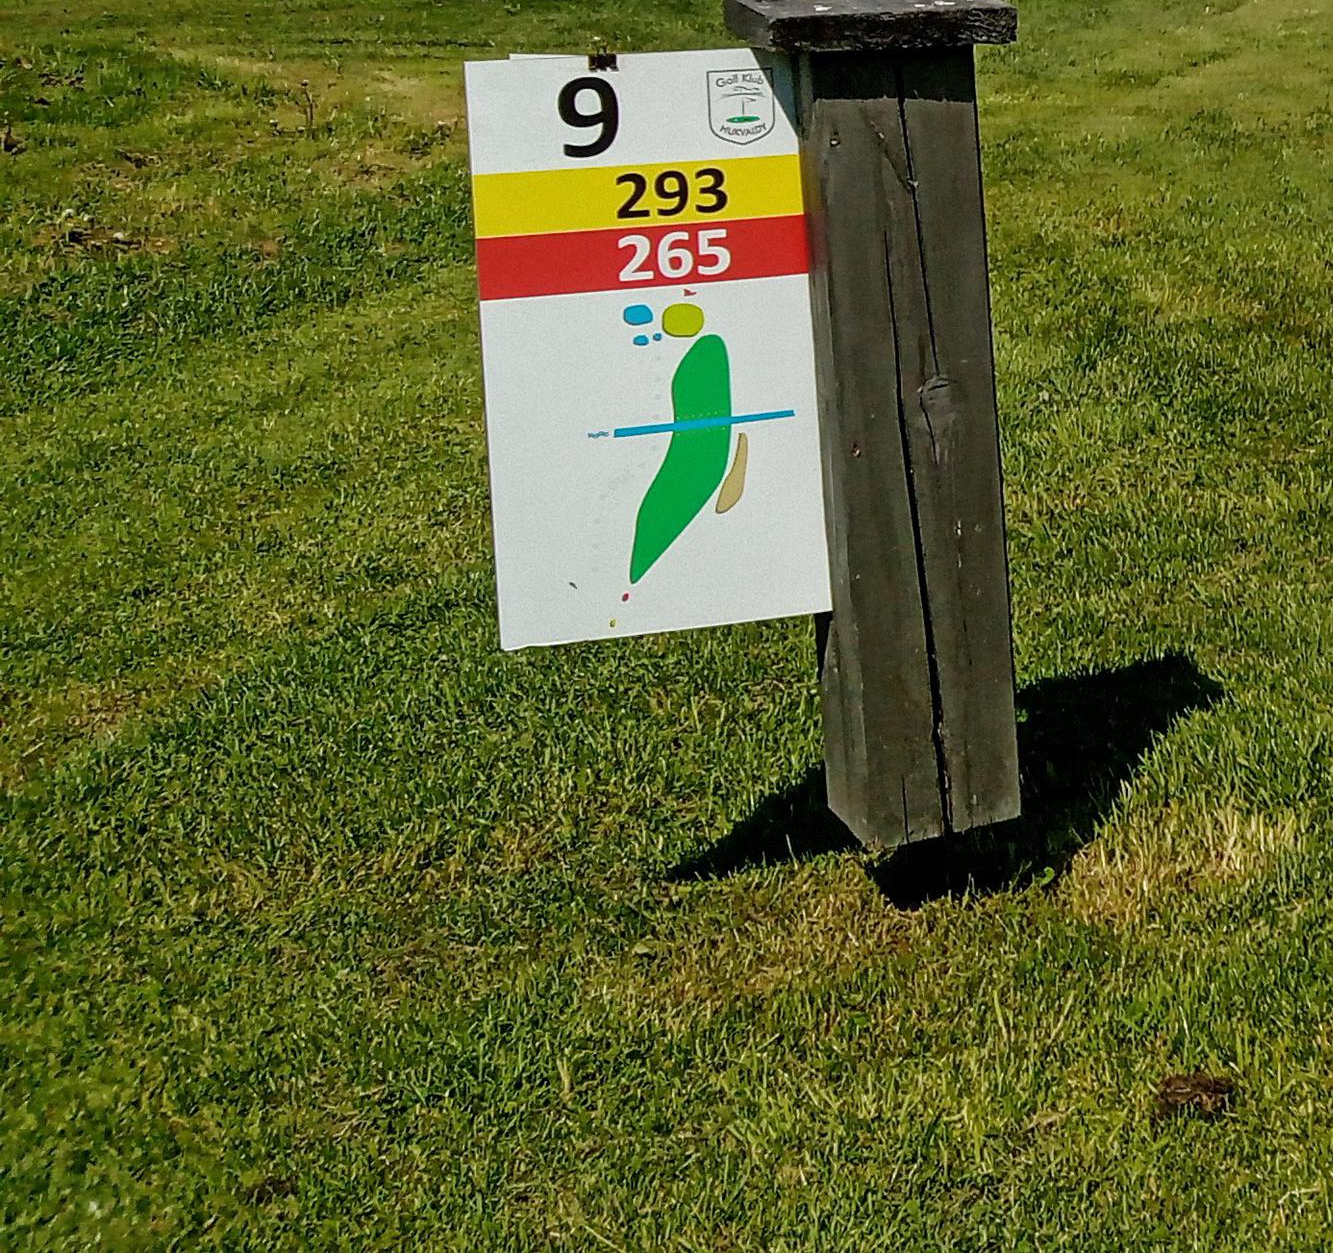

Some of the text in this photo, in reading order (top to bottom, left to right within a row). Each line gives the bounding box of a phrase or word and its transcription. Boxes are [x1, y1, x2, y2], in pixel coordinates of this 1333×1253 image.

[742, 73, 764, 85] Klub
[558, 77, 619, 158] 9
[616, 168, 728, 219] 293
[618, 229, 731, 282] 265
